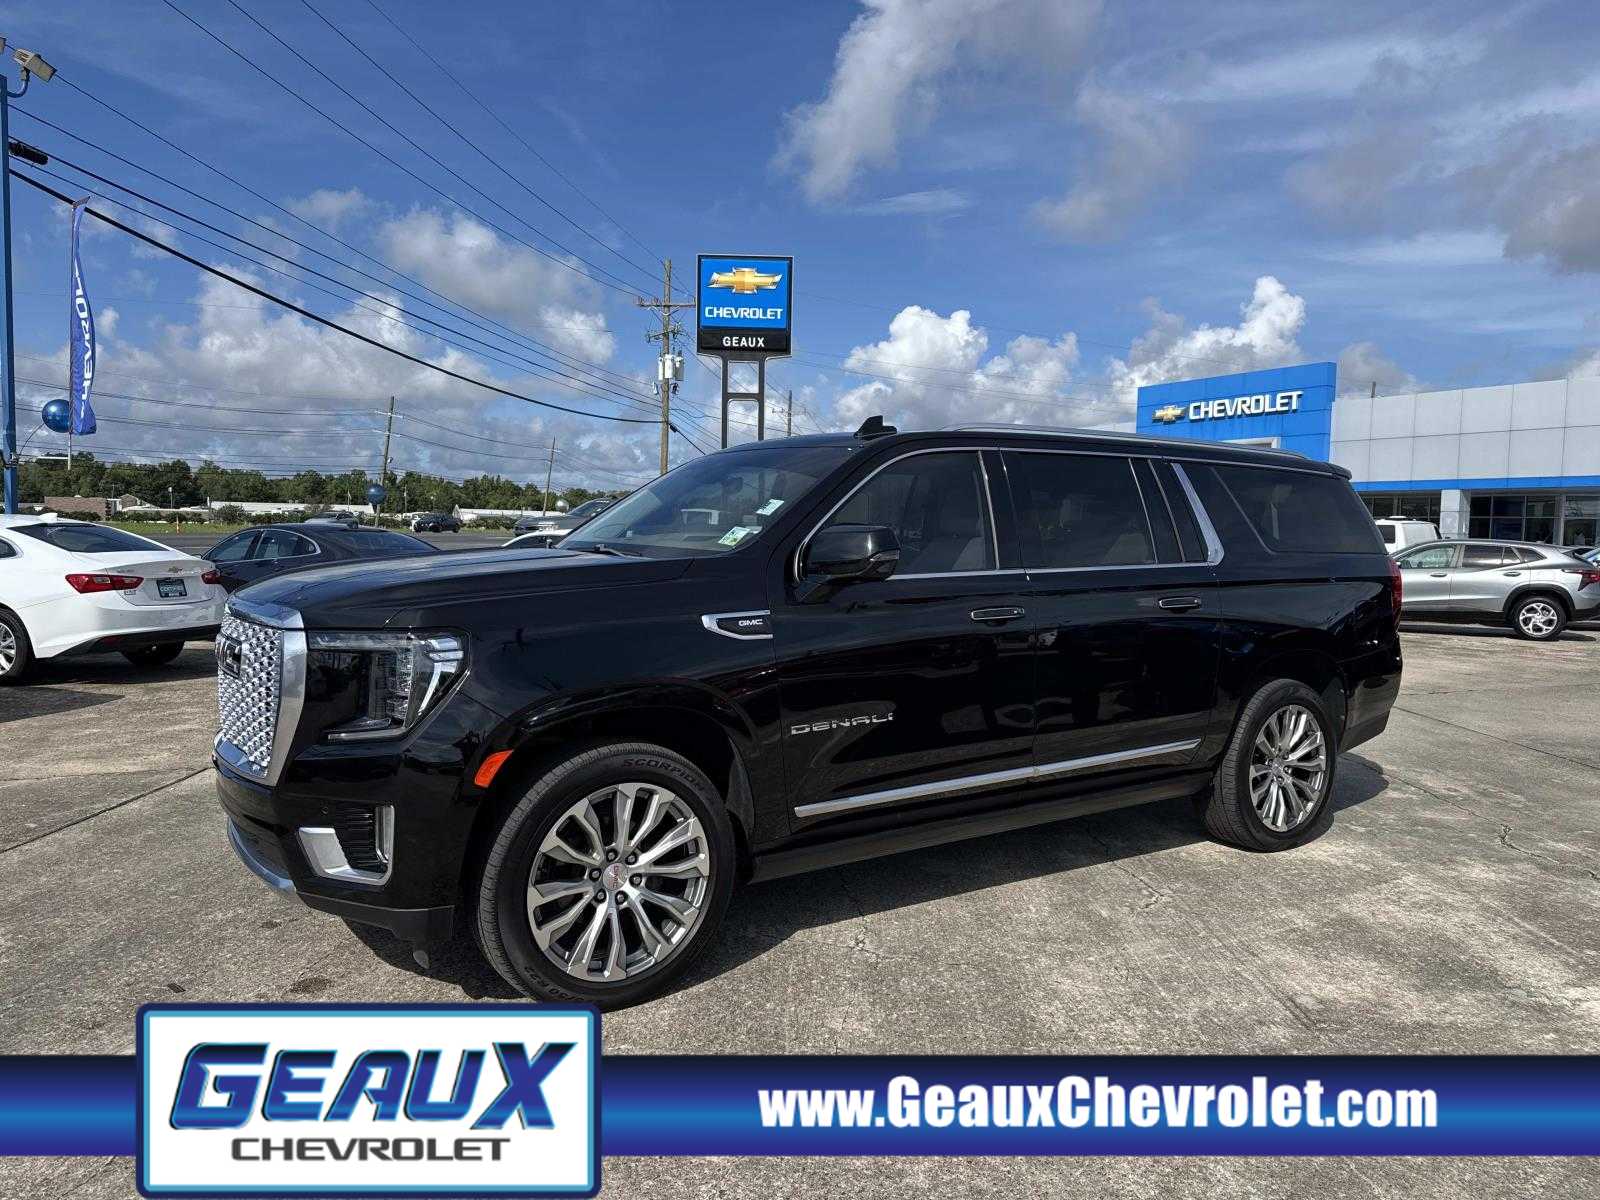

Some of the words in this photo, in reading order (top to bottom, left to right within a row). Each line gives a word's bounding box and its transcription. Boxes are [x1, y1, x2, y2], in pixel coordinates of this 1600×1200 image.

[704, 306, 783, 320] CHEVROLET
[74, 257, 93, 418] HEVROL
[722, 336, 765, 348] GEAUX
[1188, 391, 1304, 421] CHEVROLET
[738, 618, 764, 627] GMC
[791, 712, 894, 735] DENALI
